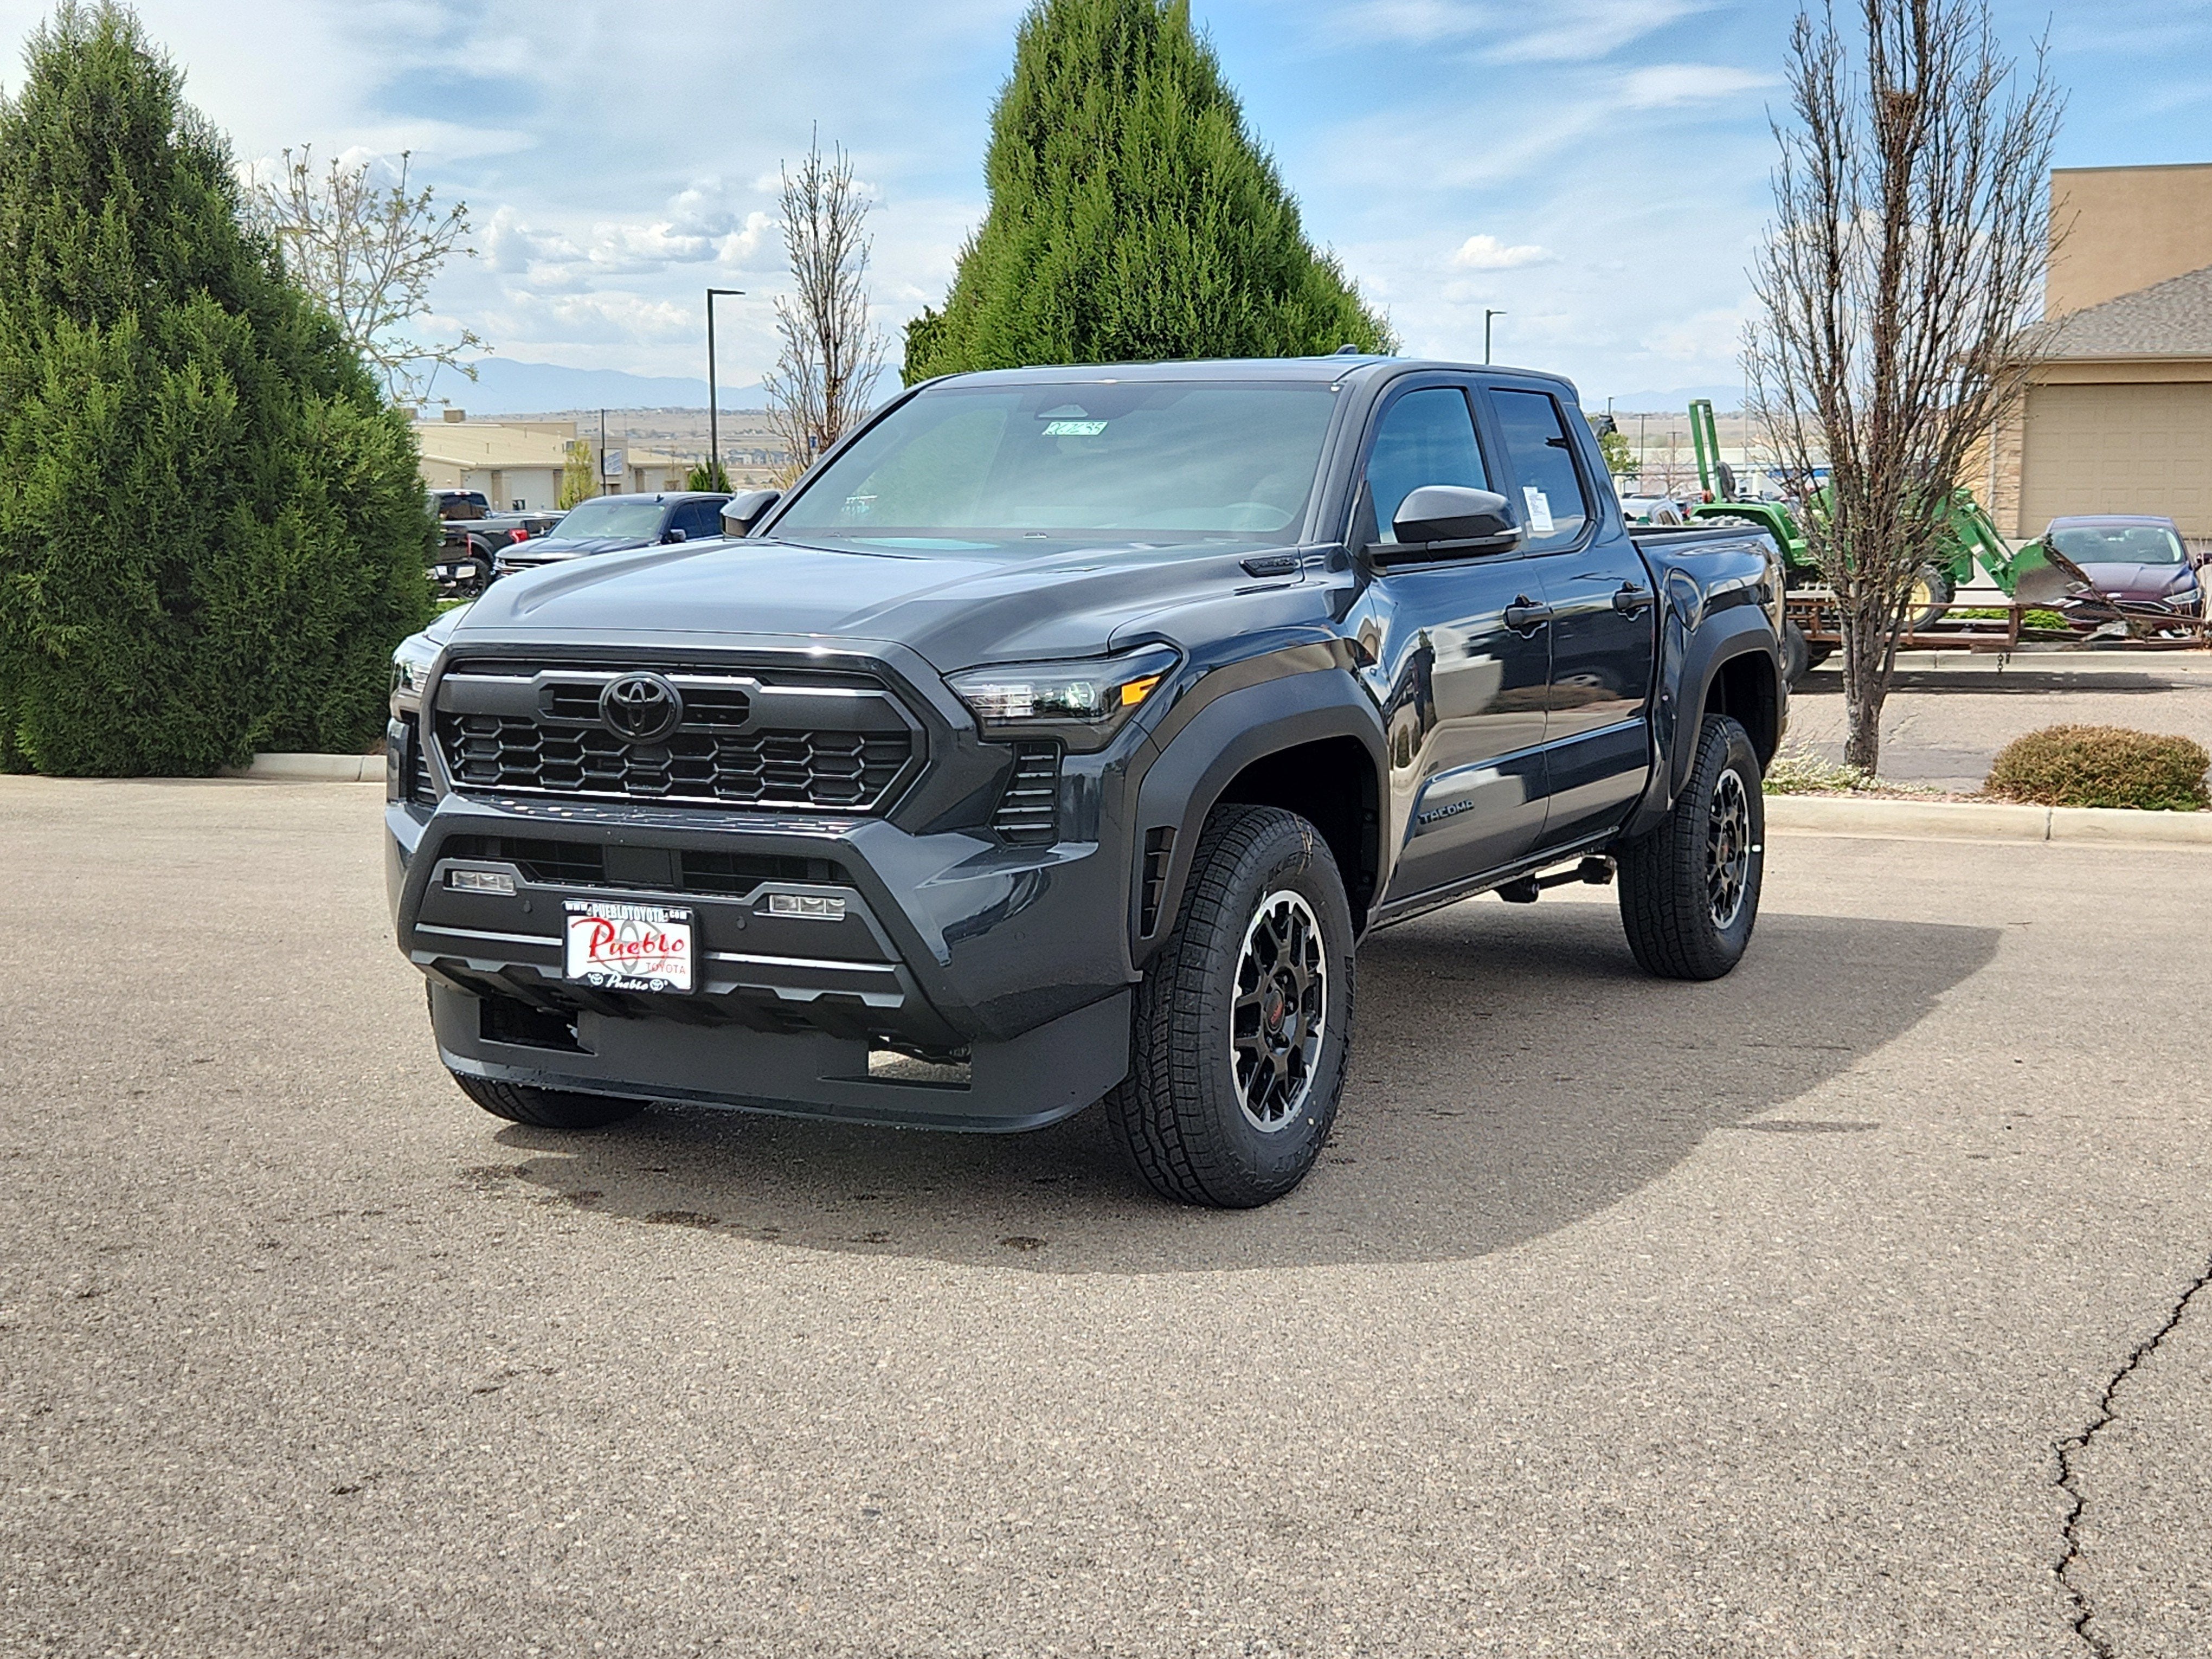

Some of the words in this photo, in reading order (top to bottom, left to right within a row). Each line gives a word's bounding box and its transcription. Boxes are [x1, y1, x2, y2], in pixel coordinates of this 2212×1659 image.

[1419, 800, 1475, 825] TACOMA
[571, 917, 685, 957] Pueblo
[646, 962, 686, 974] TOYOTA
[606, 971, 649, 991] Pueblo
